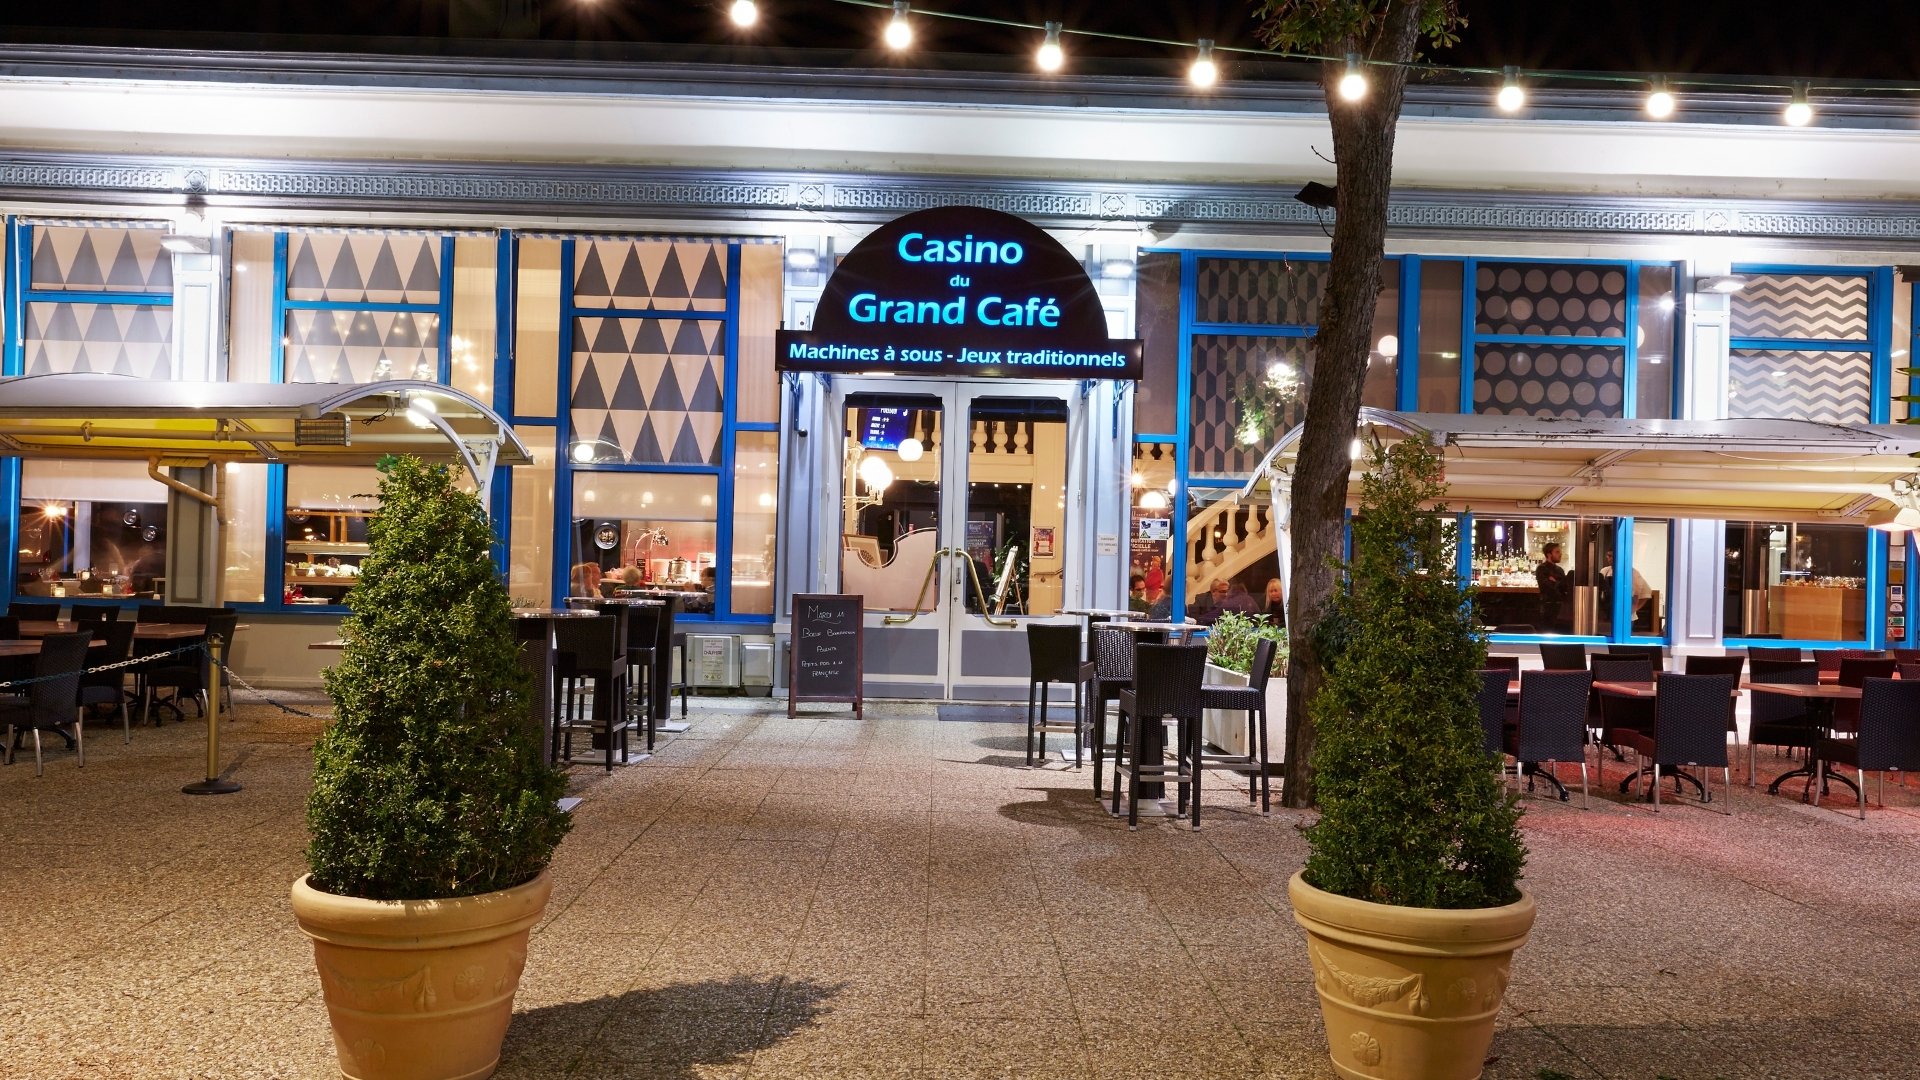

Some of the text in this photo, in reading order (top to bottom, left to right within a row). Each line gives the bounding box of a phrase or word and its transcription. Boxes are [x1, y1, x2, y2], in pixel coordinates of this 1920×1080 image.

[898, 232, 1024, 265] Casino
[949, 274, 970, 288] du
[848, 293, 1061, 328] Grand Café
[789, 343, 880, 361] Machines
[883, 345, 896, 361] à
[899, 349, 943, 363] sous
[956, 347, 1002, 364] Jeux
[1006, 349, 1126, 368] traditionnels
